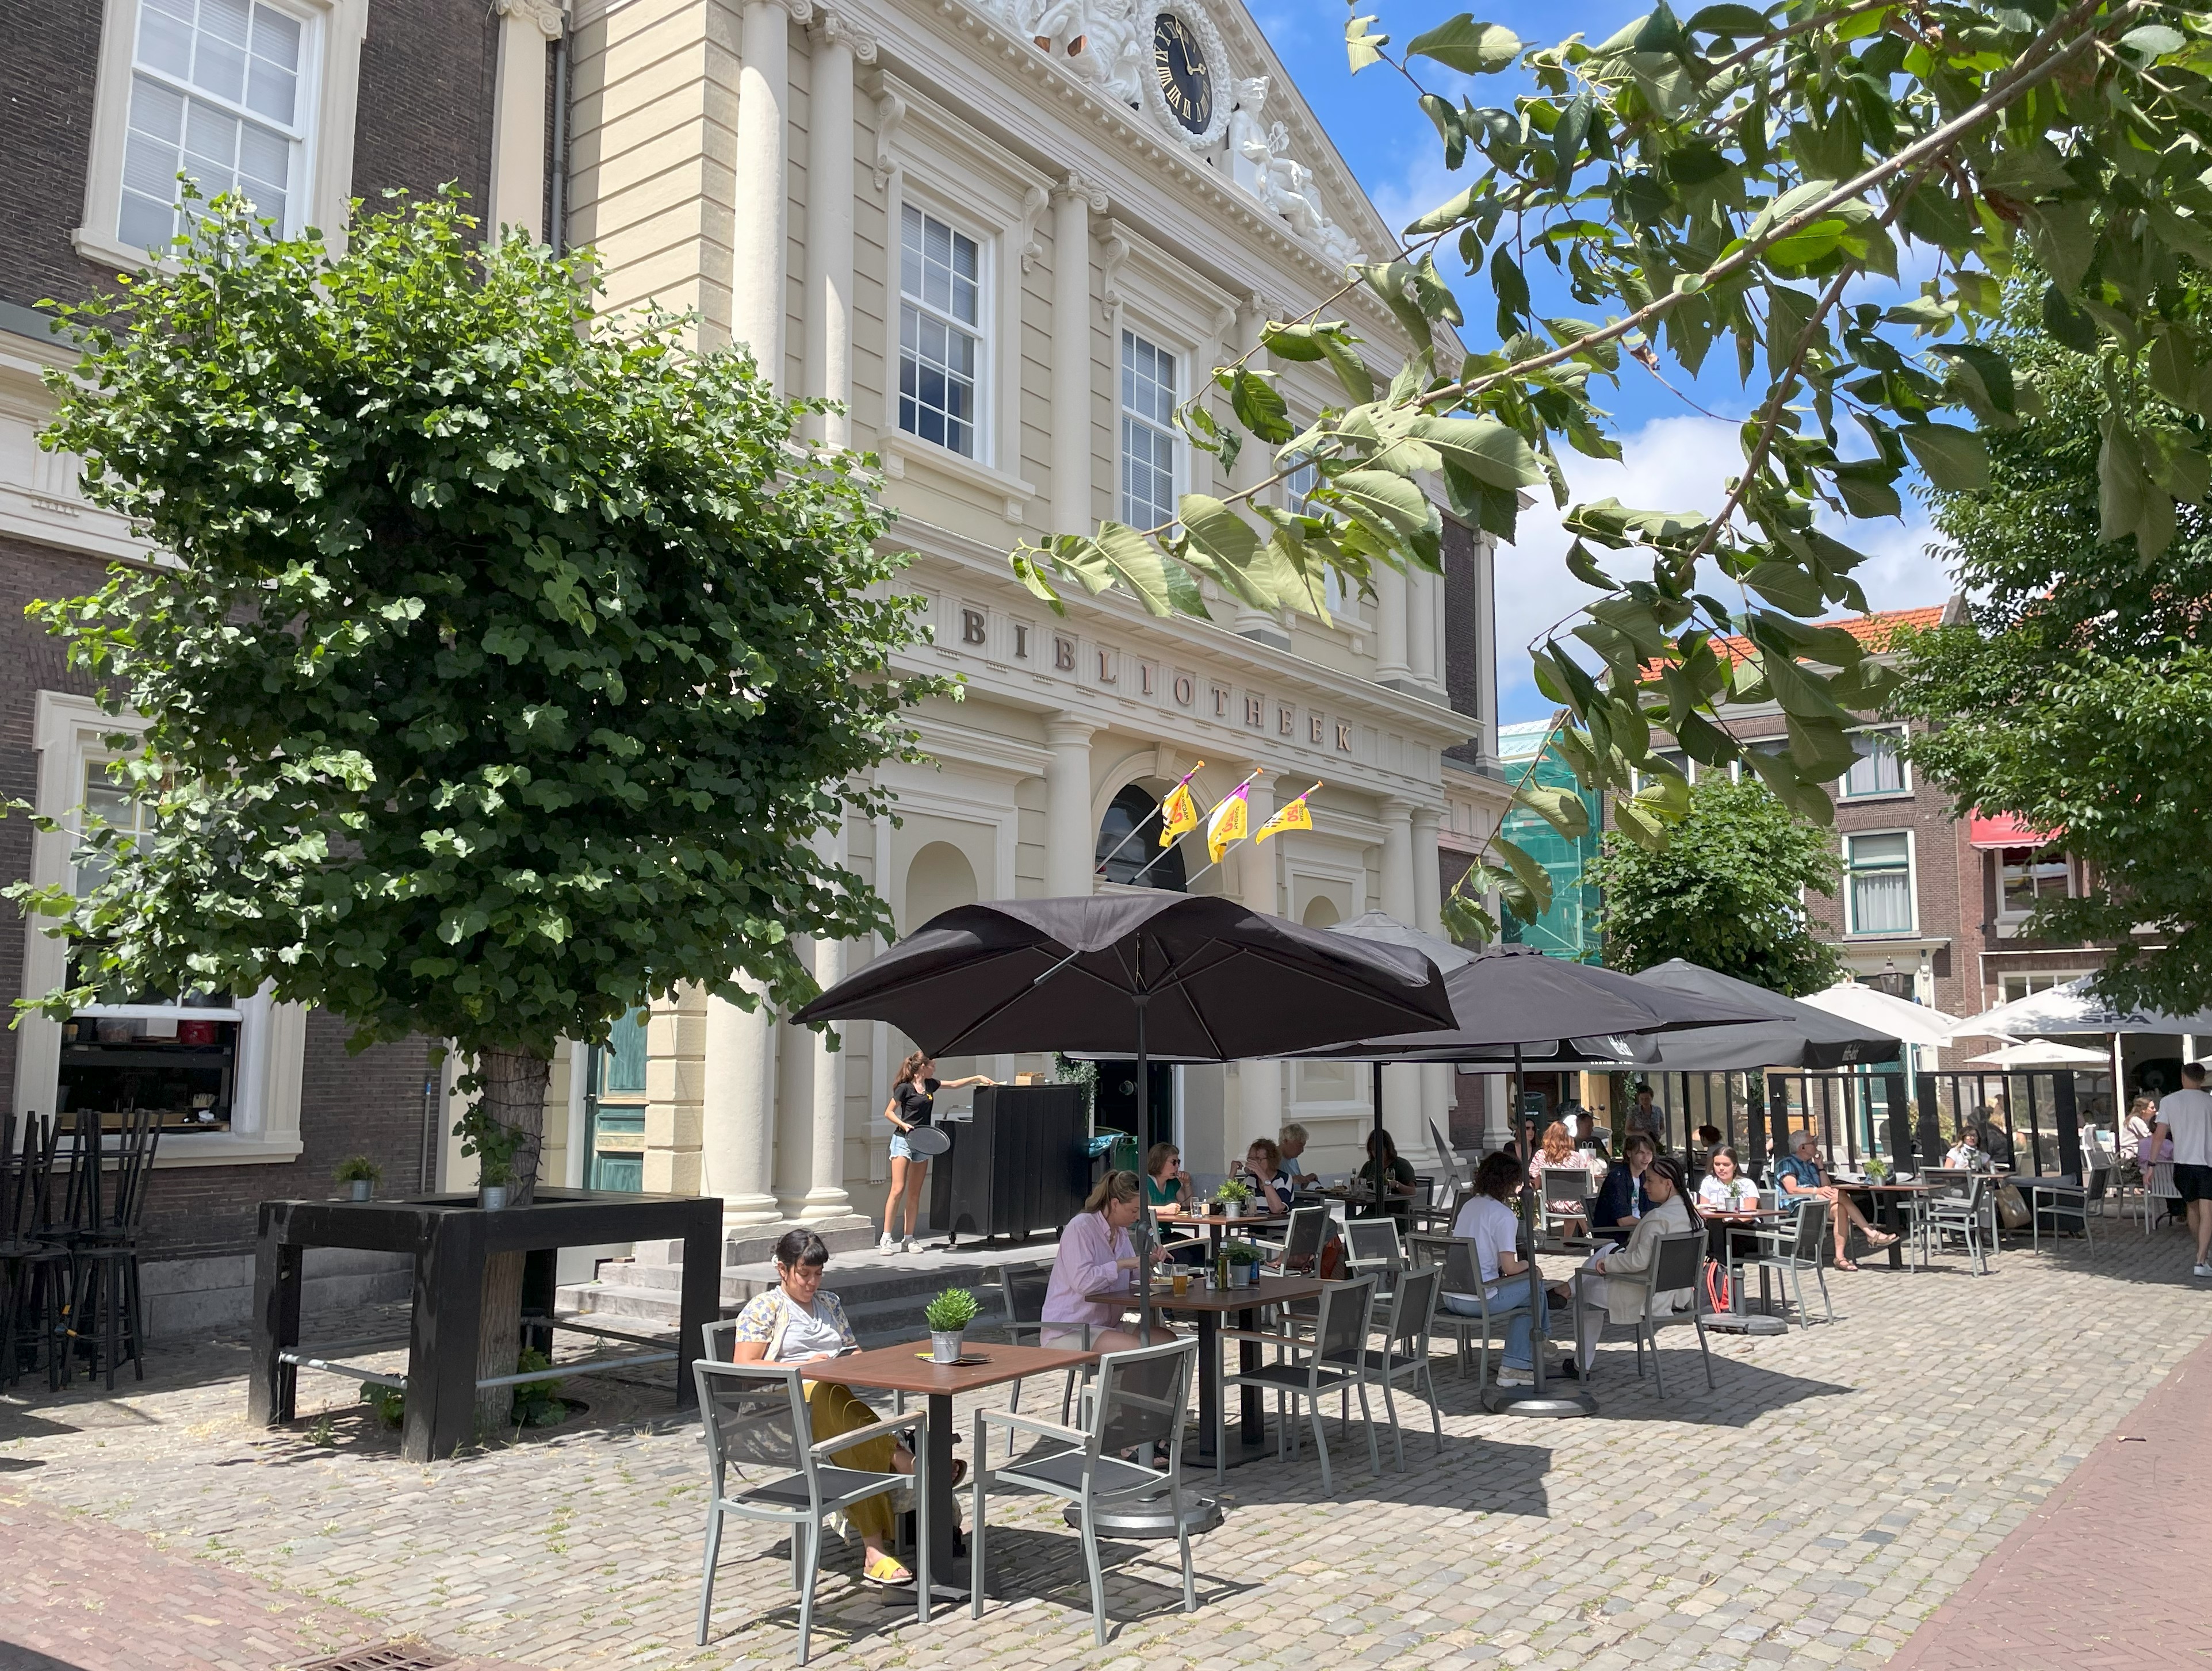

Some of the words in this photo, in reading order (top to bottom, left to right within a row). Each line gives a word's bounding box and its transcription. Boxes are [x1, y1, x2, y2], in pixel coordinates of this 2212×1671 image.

[963, 608, 1352, 752] BIBLIOTHEEK
[1287, 804, 1299, 822] 750
[2078, 1014, 2153, 1024] SPA
